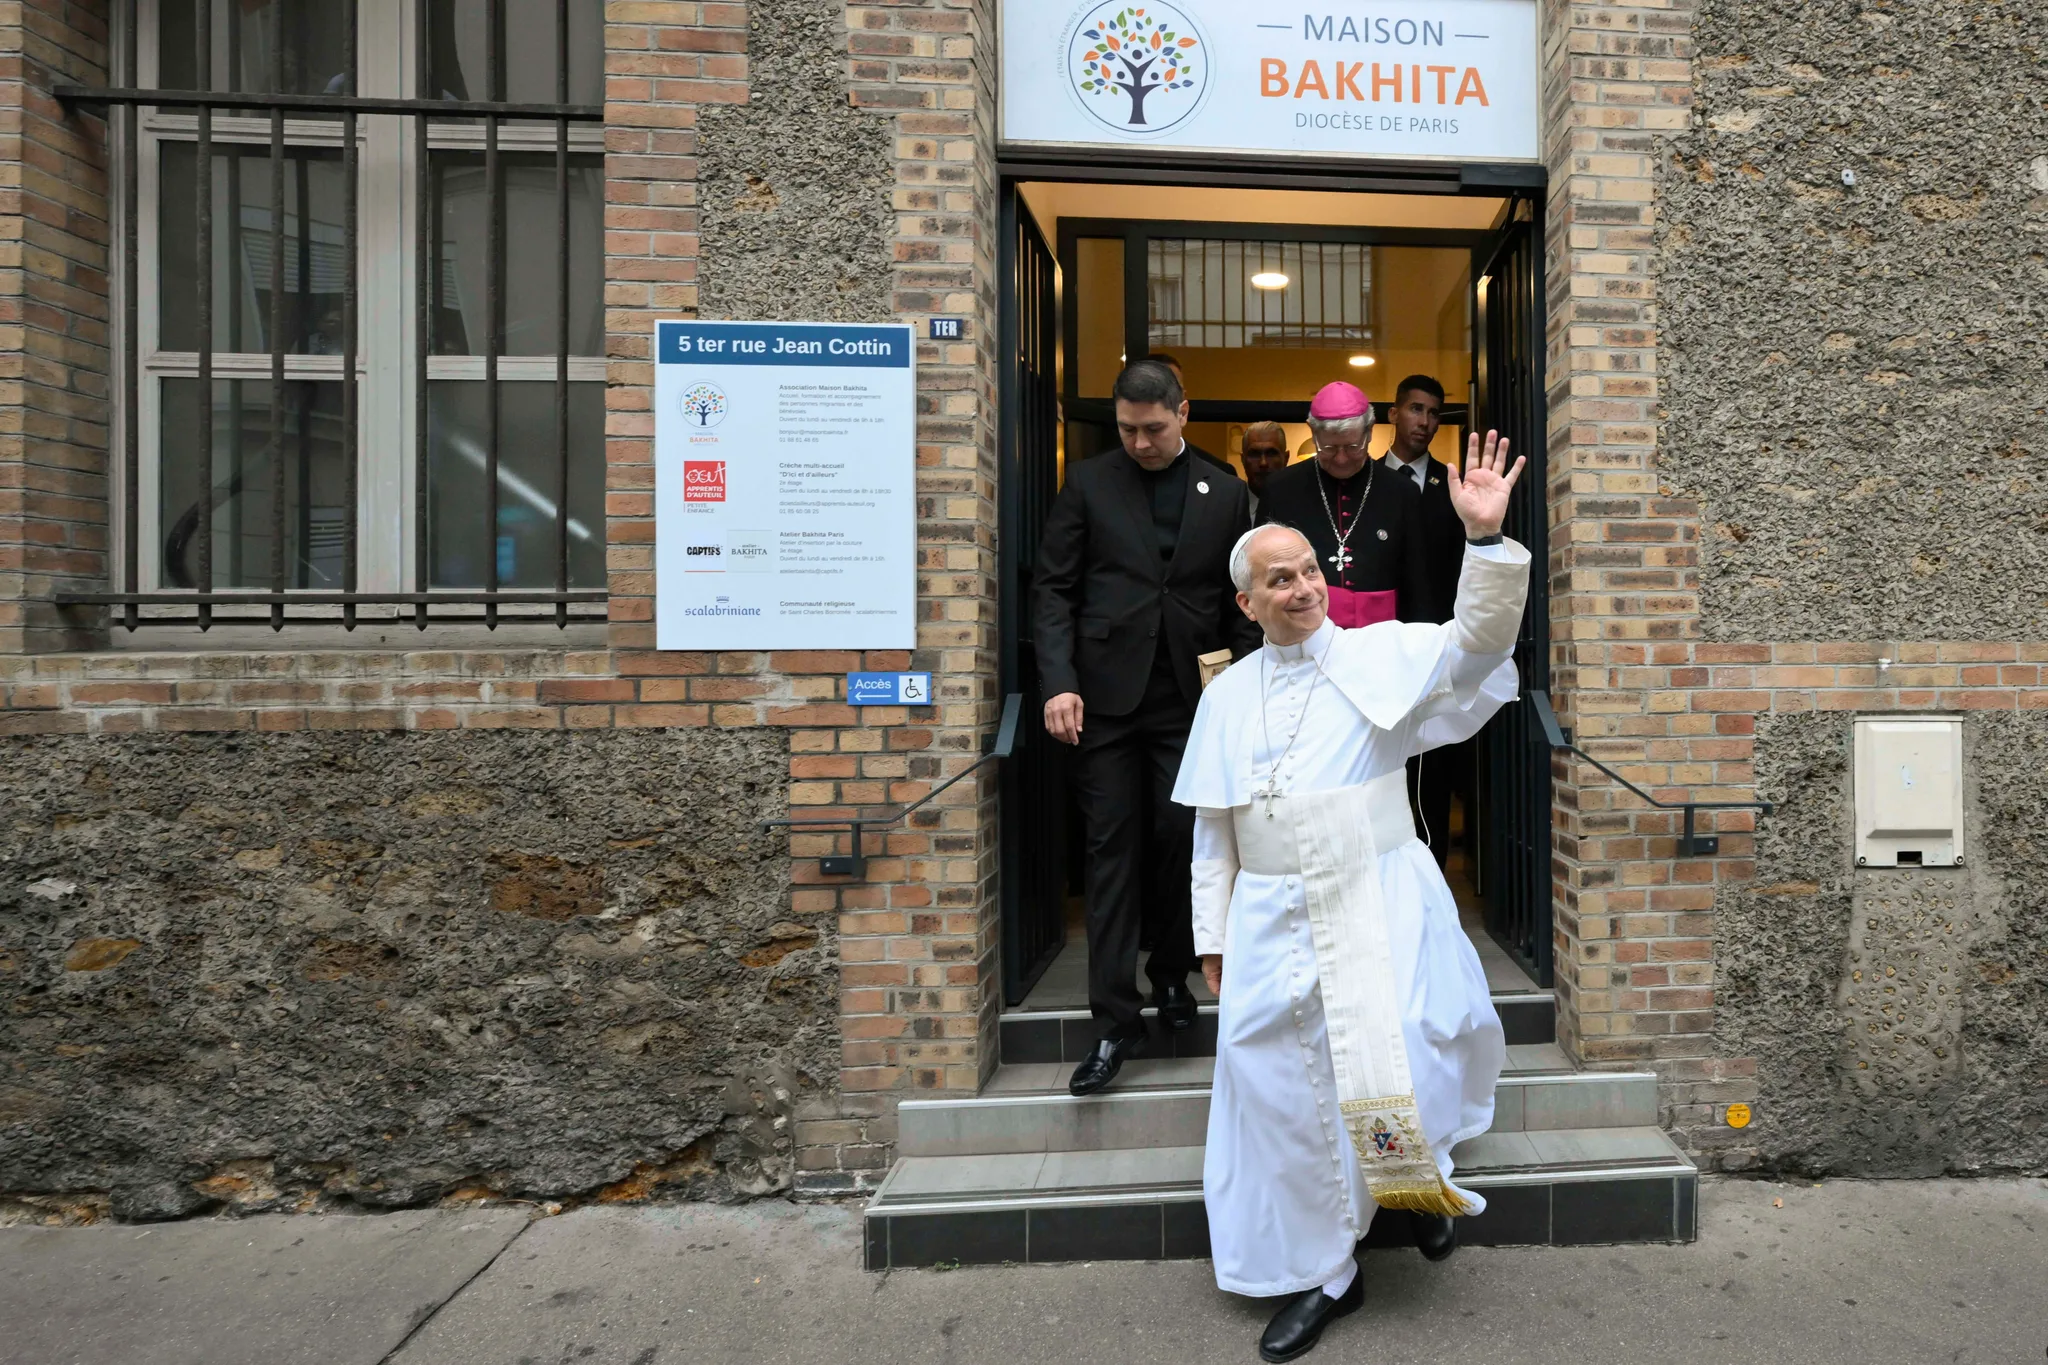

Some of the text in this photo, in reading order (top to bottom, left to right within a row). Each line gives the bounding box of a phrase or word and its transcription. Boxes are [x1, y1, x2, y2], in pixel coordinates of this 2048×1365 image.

[1304, 14, 1443, 46] MAISON
[1260, 58, 1489, 106] BAKHITA
[1296, 111, 1459, 134] DIOCÈSE DE PARIS
[934, 321, 957, 336] TER
[678, 336, 891, 356] 5 ter rue Jean Cottin
[685, 605, 760, 616] scalabriniane
[854, 679, 892, 689] Accès
